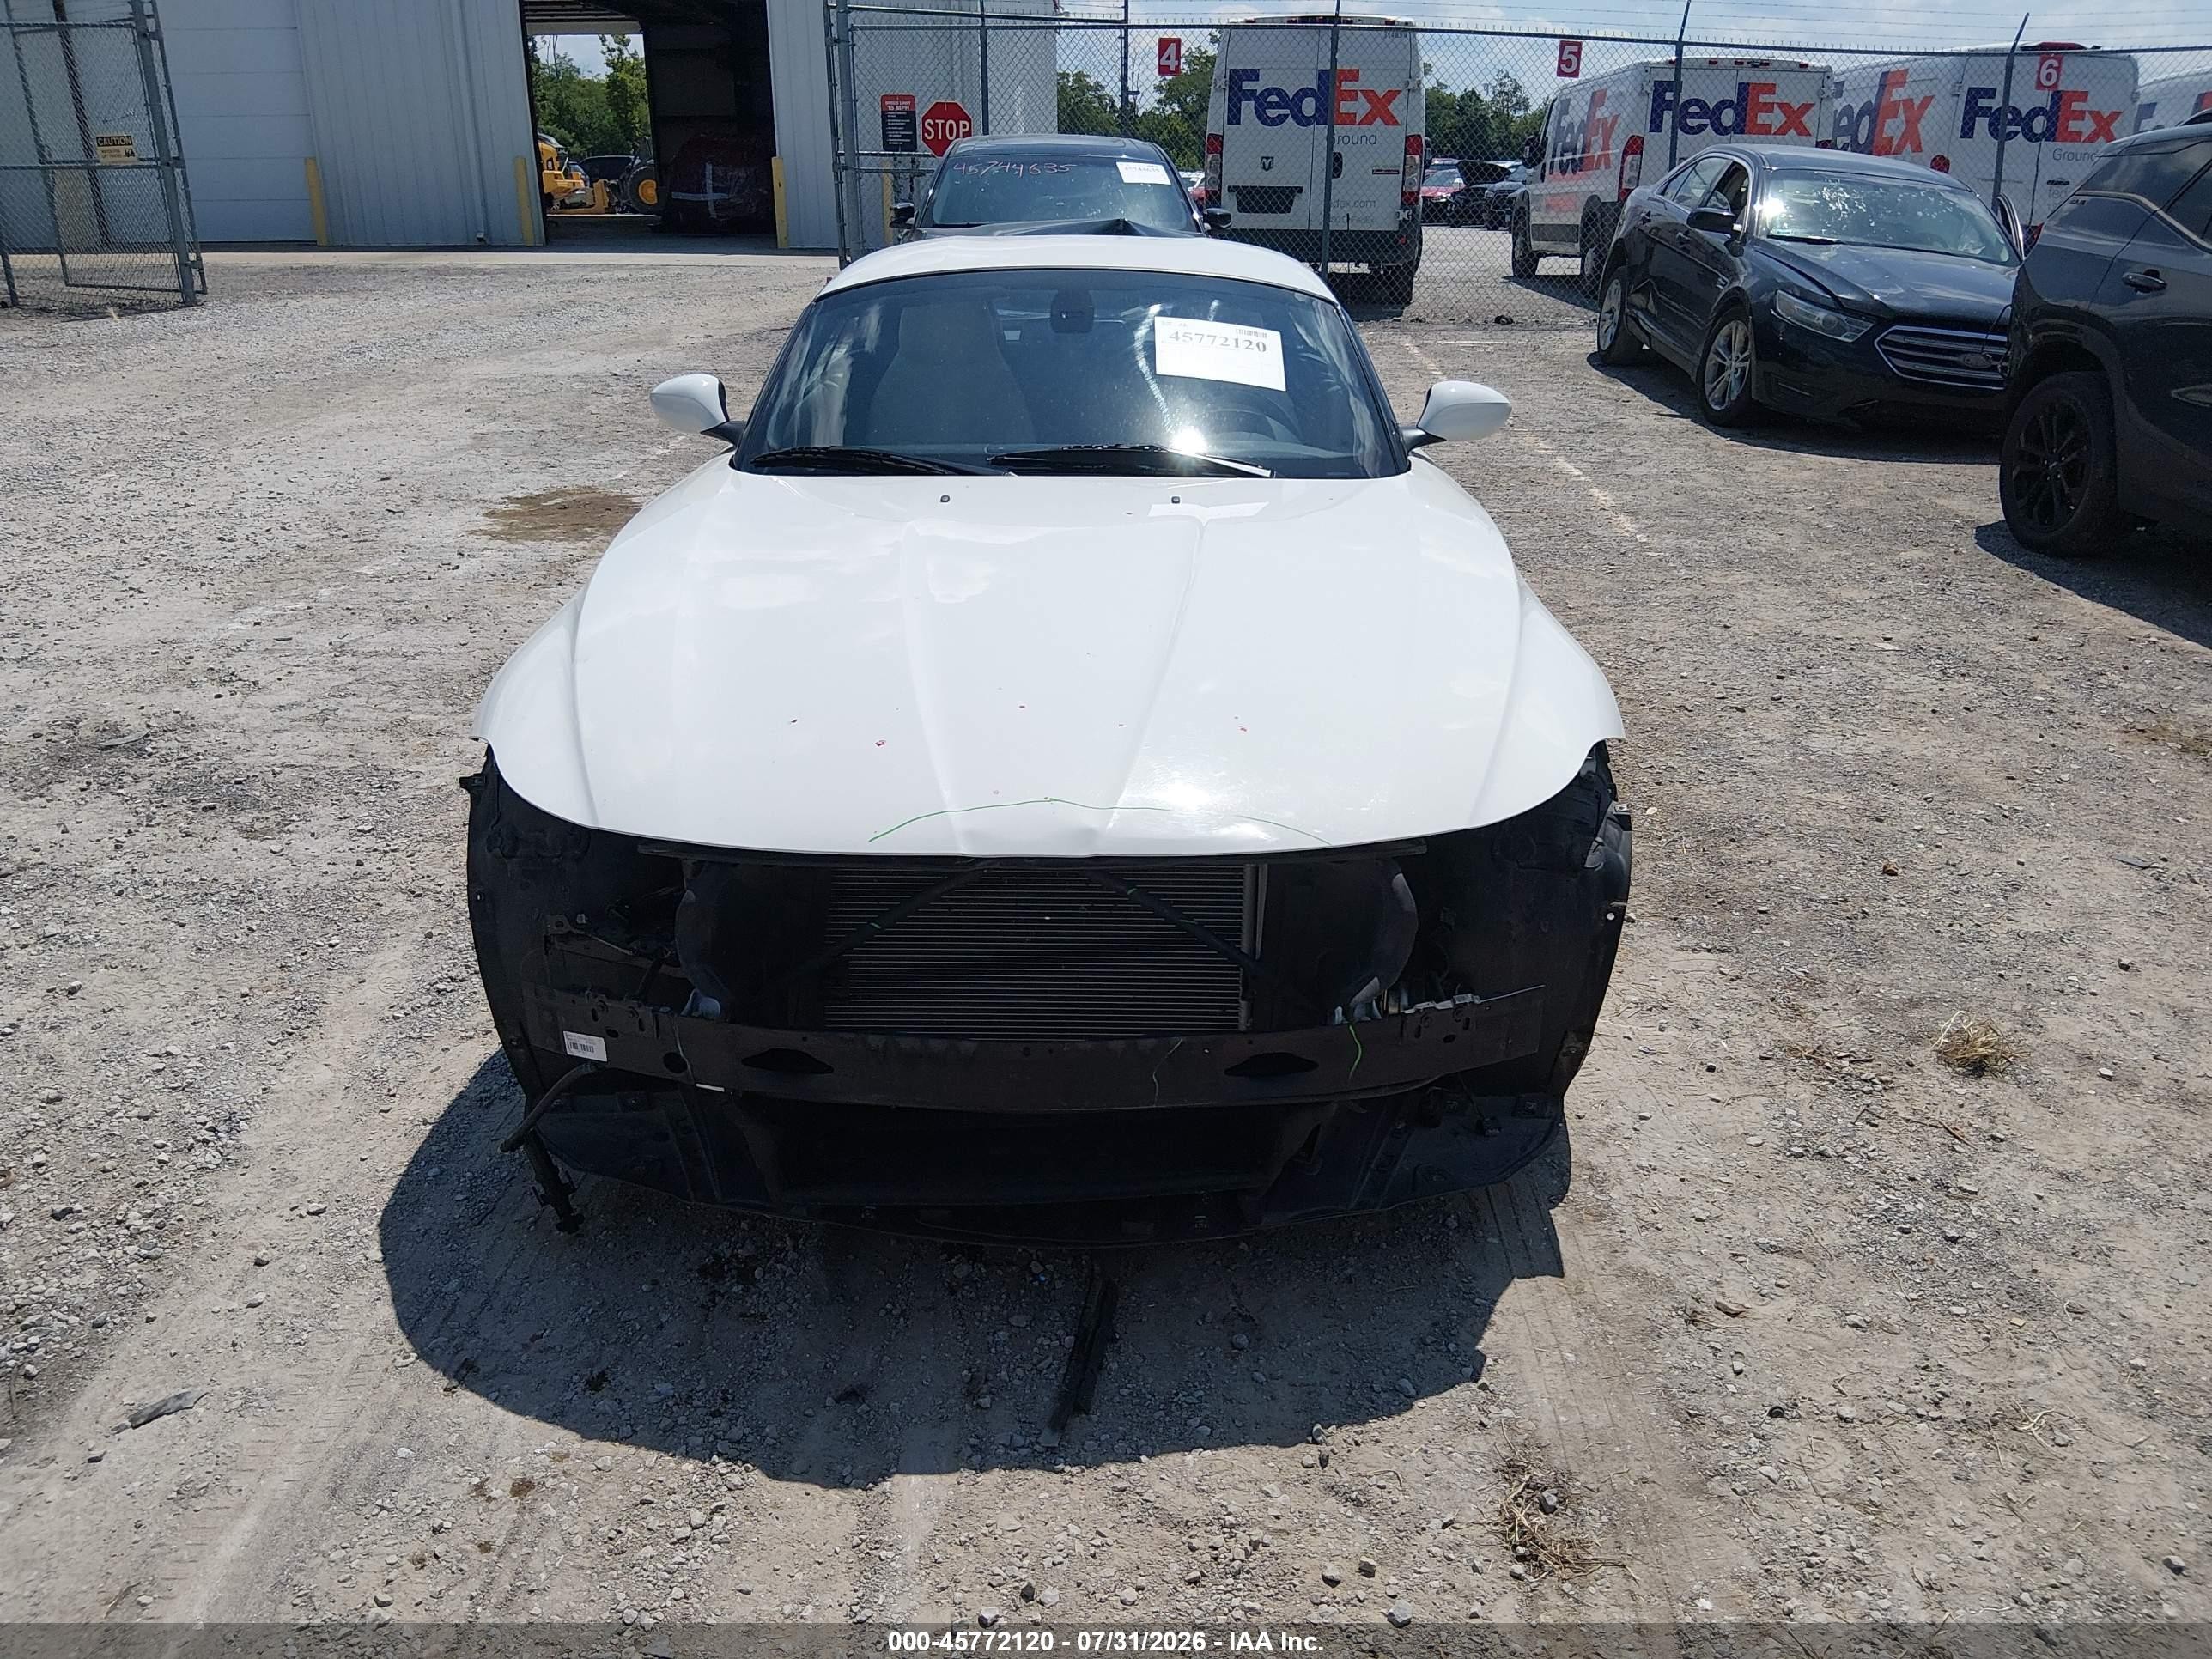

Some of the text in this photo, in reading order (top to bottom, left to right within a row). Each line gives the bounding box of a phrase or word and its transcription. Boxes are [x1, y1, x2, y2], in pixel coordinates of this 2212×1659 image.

[1160, 42, 1179, 72] 4
[1559, 46, 1580, 74] 5
[2039, 58, 2059, 87] 6
[1226, 68, 1403, 128] FedEx
[1649, 80, 1816, 137] FedEx
[924, 119, 970, 140] STOP
[1959, 87, 2124, 143] FedEx
[97, 137, 132, 146] CAUTION
[1331, 131, 1377, 145] round
[1548, 88, 1622, 176] FedEx
[1168, 330, 1267, 353] 45772120
